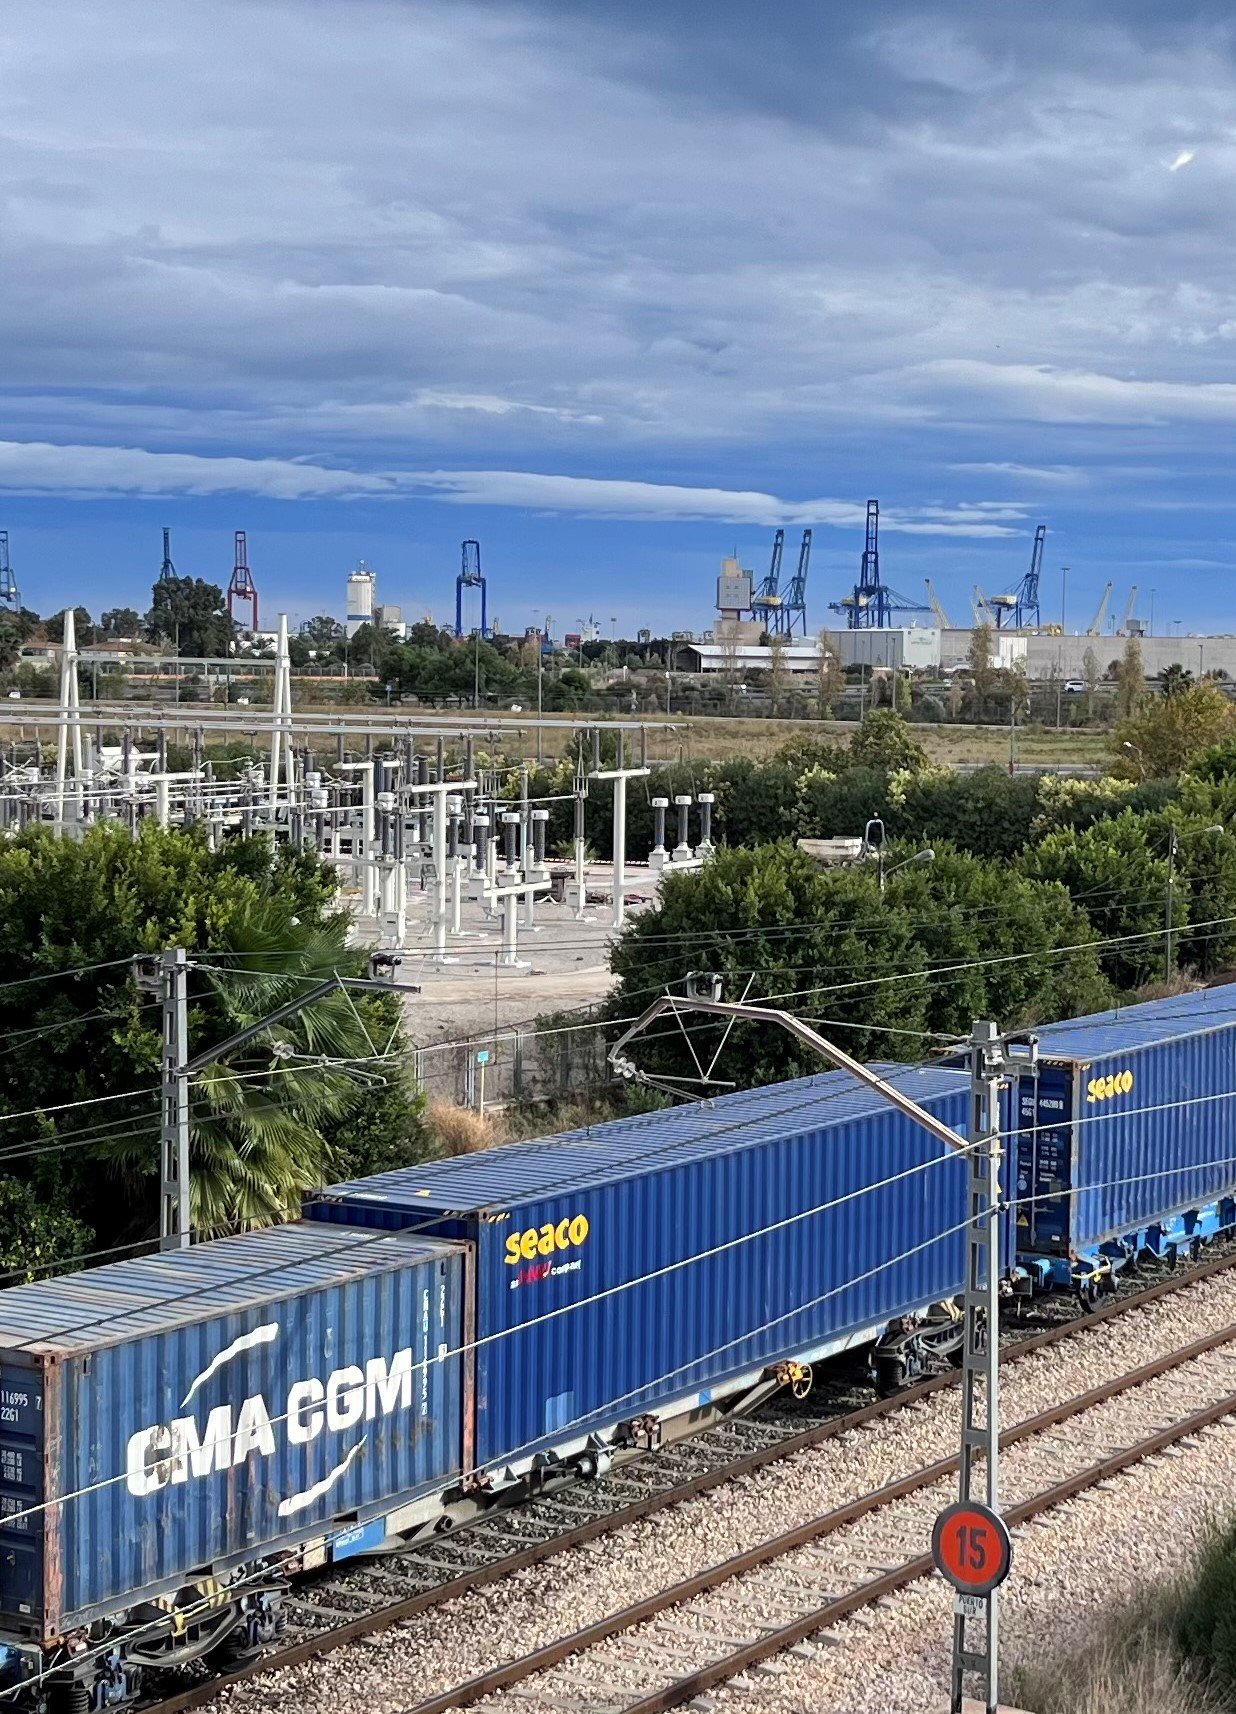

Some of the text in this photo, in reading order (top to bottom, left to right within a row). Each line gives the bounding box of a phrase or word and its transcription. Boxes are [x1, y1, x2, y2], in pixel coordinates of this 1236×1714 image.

[1086, 1069, 1134, 1104] seaco
[504, 1213, 590, 1266] seaco
[127, 1347, 413, 1497] CMA CGM
[955, 1524, 987, 1570] 15
